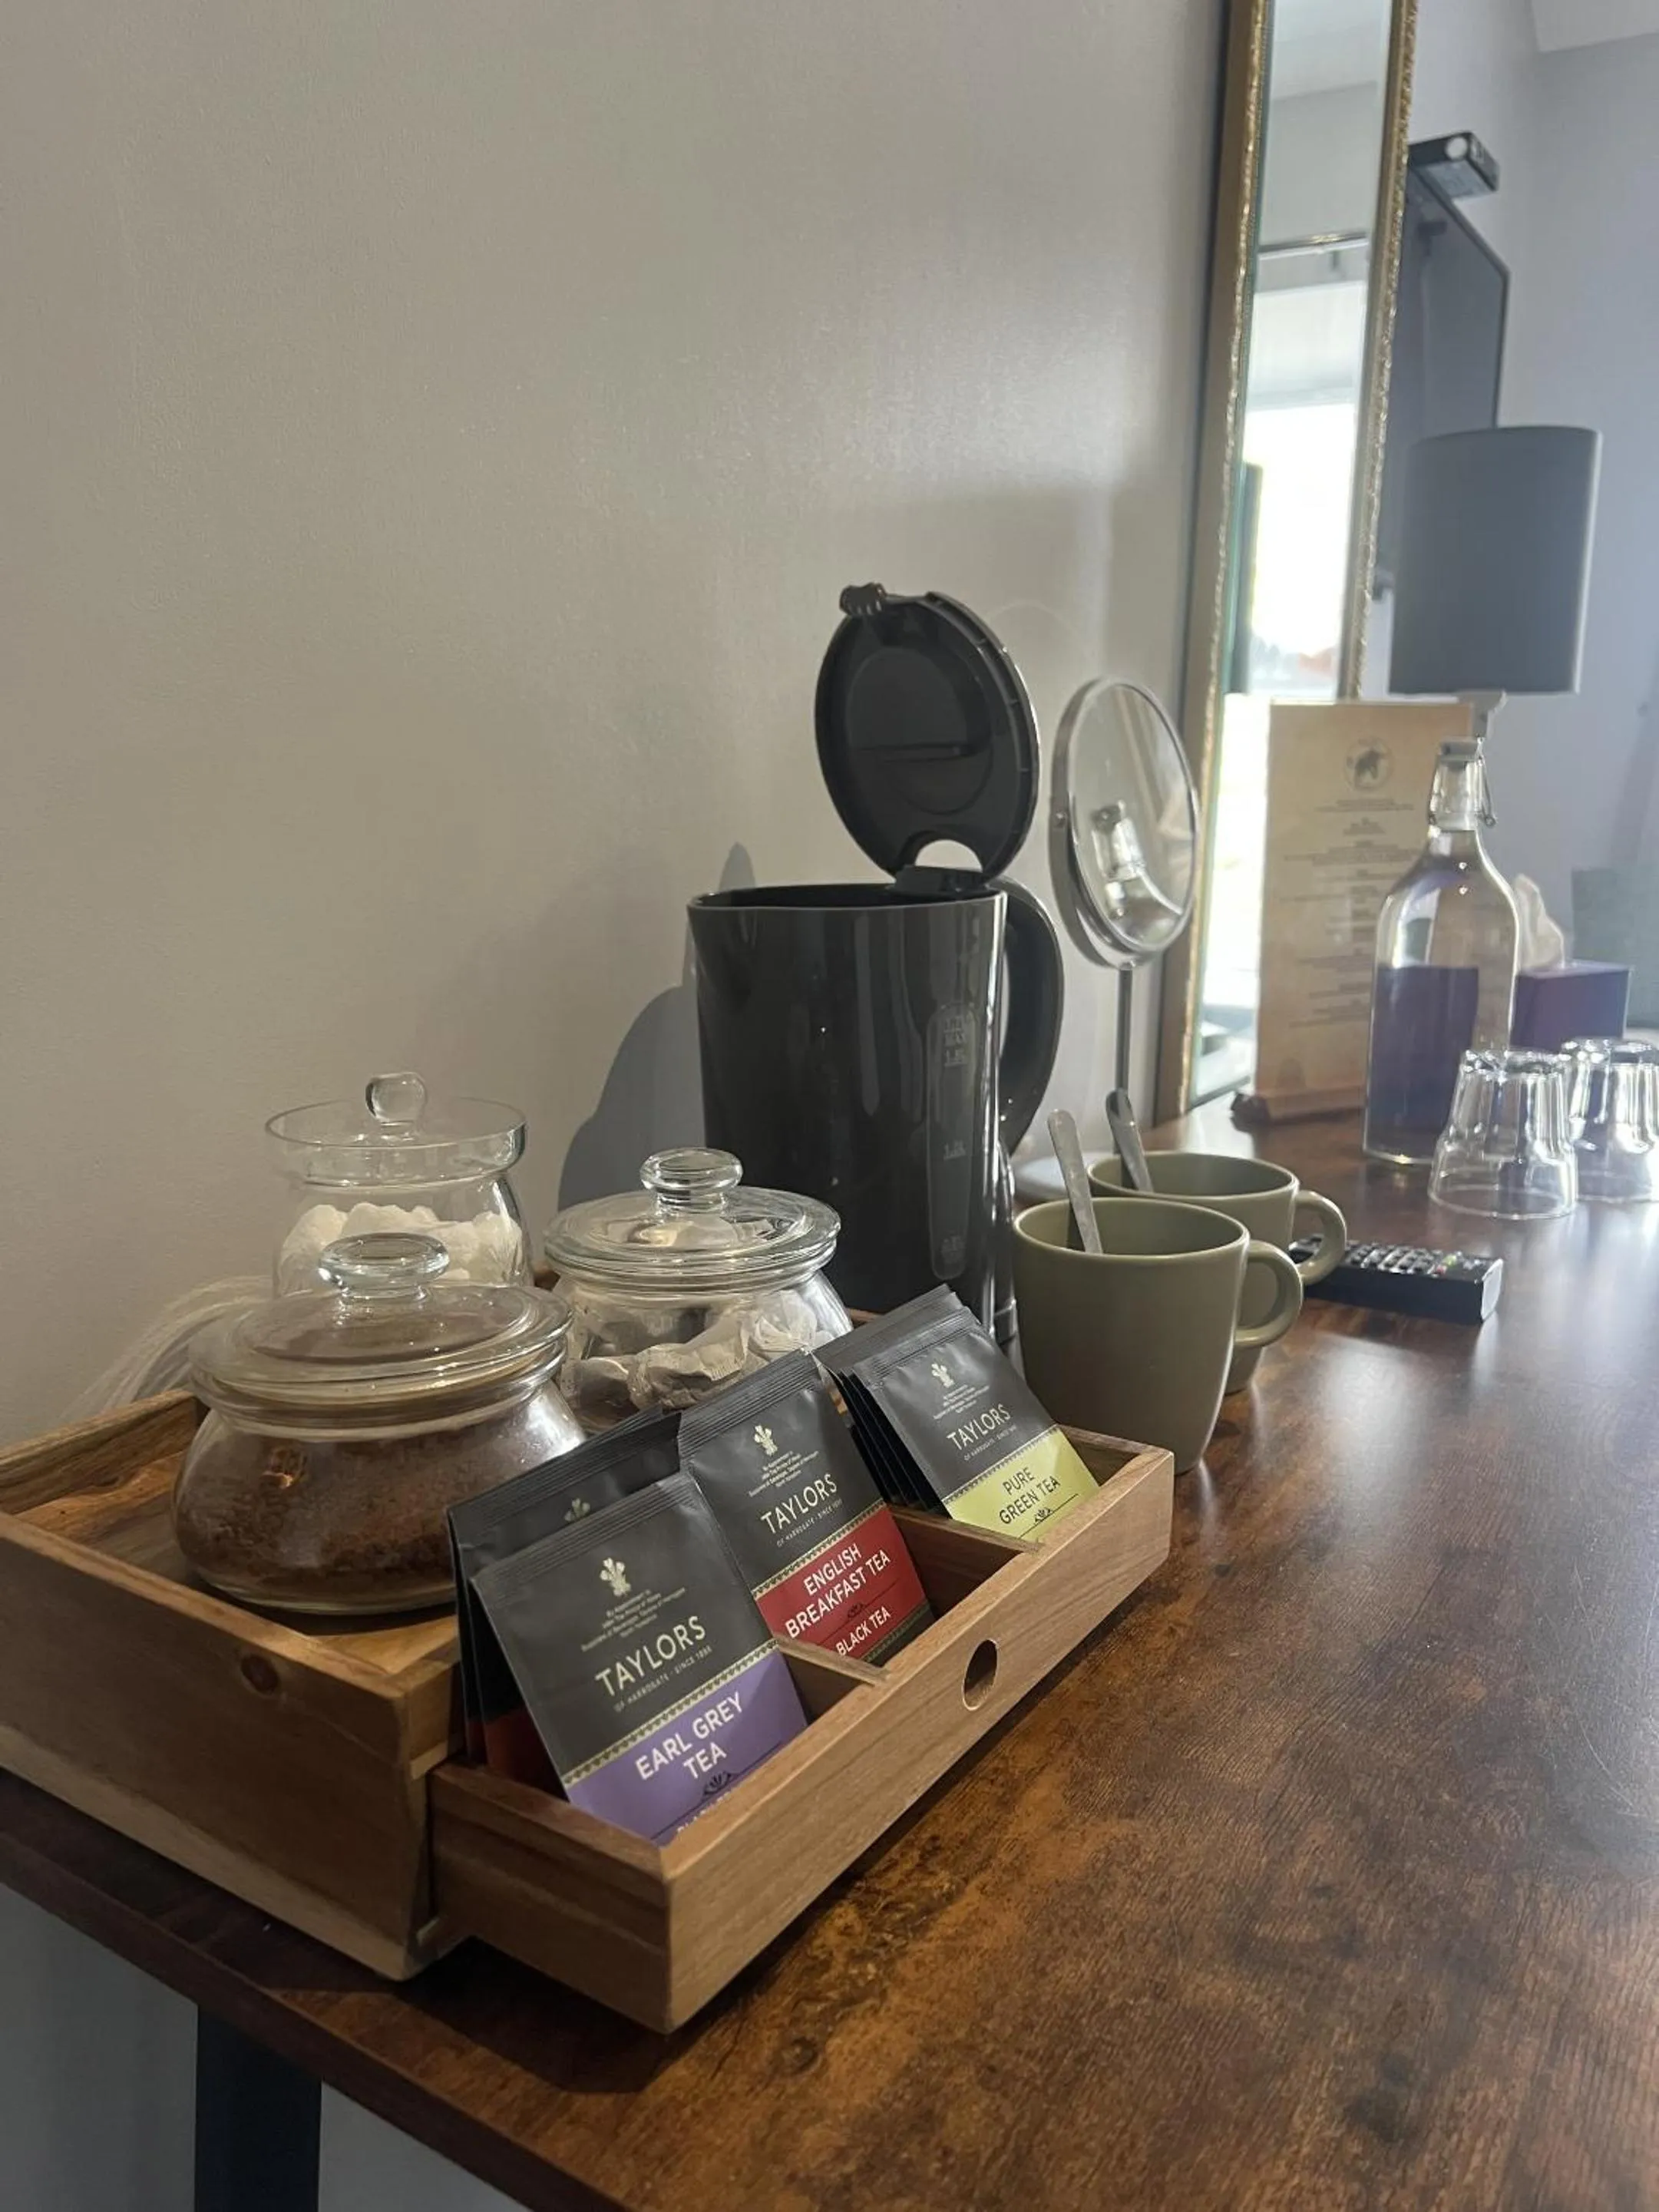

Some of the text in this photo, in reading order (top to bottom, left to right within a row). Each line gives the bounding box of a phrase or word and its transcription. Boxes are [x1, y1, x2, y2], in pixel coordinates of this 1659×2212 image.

[947, 1404, 1011, 1450] TAYLORS
[760, 1473, 838, 1534] TAYLORS
[1000, 1476, 1061, 1524] GREEN TEA
[1003, 1466, 1035, 1496] PURE
[785, 1549, 891, 1638] BREAKFAST TEA
[803, 1542, 862, 1596] ENGLISH
[595, 1615, 706, 1696] TAYLORS
[835, 1606, 891, 1655] BLACK TEA
[635, 1691, 743, 1780] EARL GREY
[683, 1741, 727, 1779] TEA
